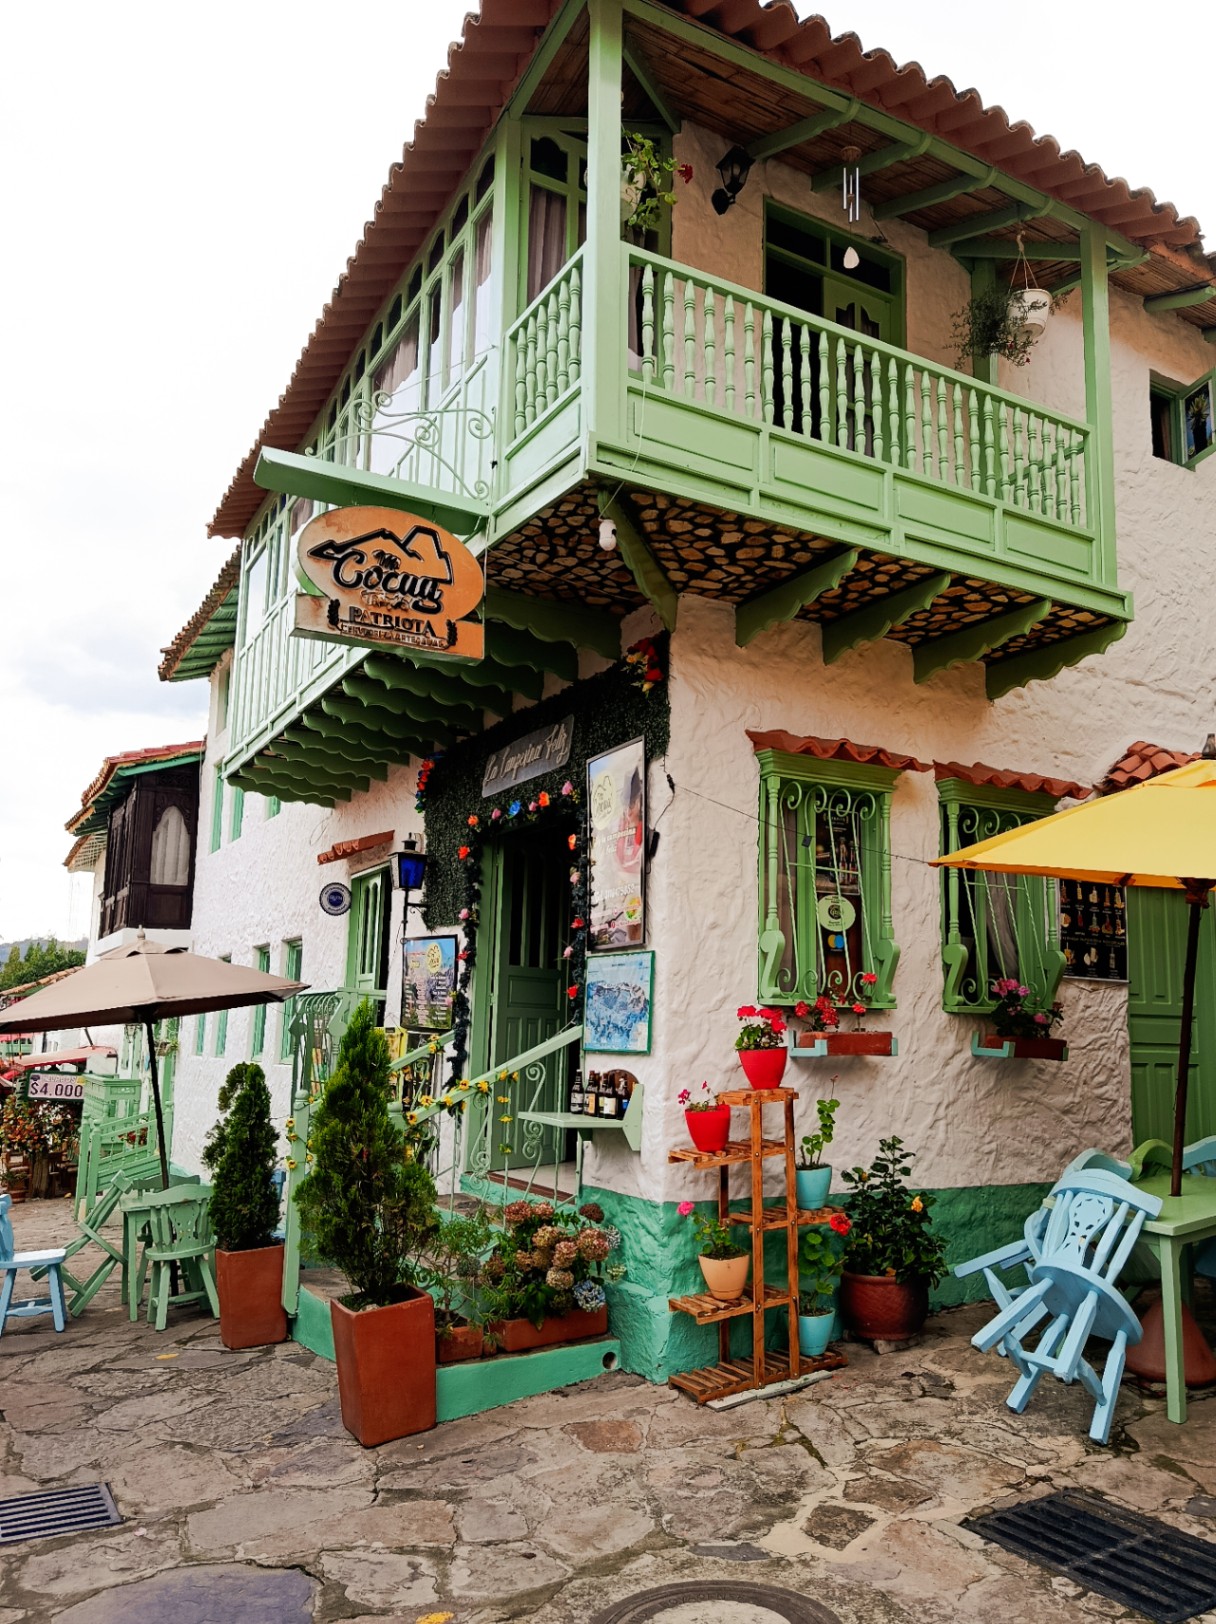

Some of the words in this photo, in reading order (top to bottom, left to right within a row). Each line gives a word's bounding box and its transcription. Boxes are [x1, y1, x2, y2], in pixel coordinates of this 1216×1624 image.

[333, 548, 443, 614] Cocuy
[348, 604, 437, 638] PATRIOTA
[30, 1081, 83, 1098] $4.000
